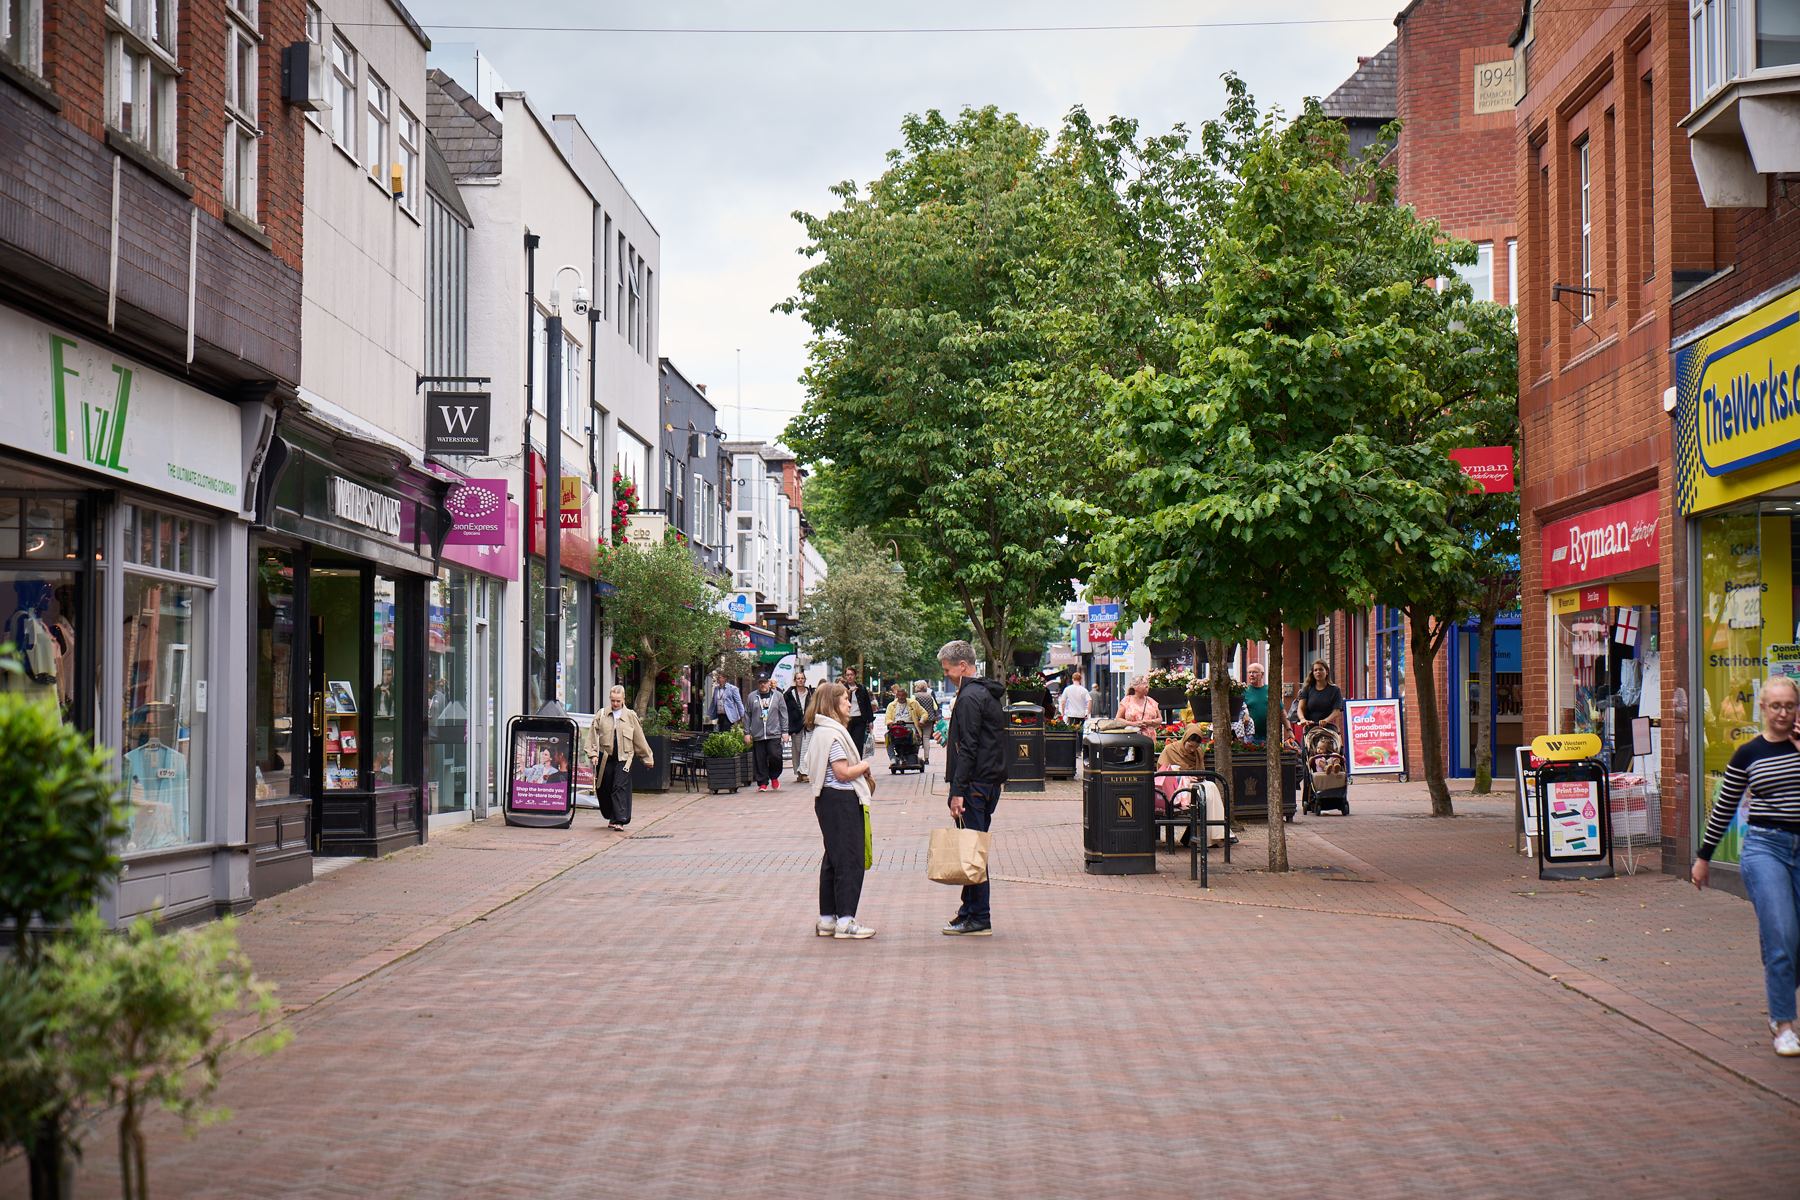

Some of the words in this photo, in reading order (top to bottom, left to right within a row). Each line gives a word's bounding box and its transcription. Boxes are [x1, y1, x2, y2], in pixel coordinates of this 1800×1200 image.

[1480, 66, 1516, 88] 1994
[438, 406, 479, 434] W
[167, 463, 176, 478] THE
[177, 465, 197, 485] ULTIMATE
[198, 473, 218, 492] CLOTHING
[218, 479, 237, 496] COMPANY
[335, 475, 401, 536] WATERSTONES
[453, 523, 498, 531] sionExpress
[1569, 521, 1630, 571] Ryman
[1725, 581, 1768, 593] Books
[1728, 617, 1766, 630] Craft
[1710, 654, 1768, 668] Statione
[1736, 691, 1754, 703] Ar
[1354, 723, 1392, 731] broadband
[1572, 787, 1589, 795] Shop
